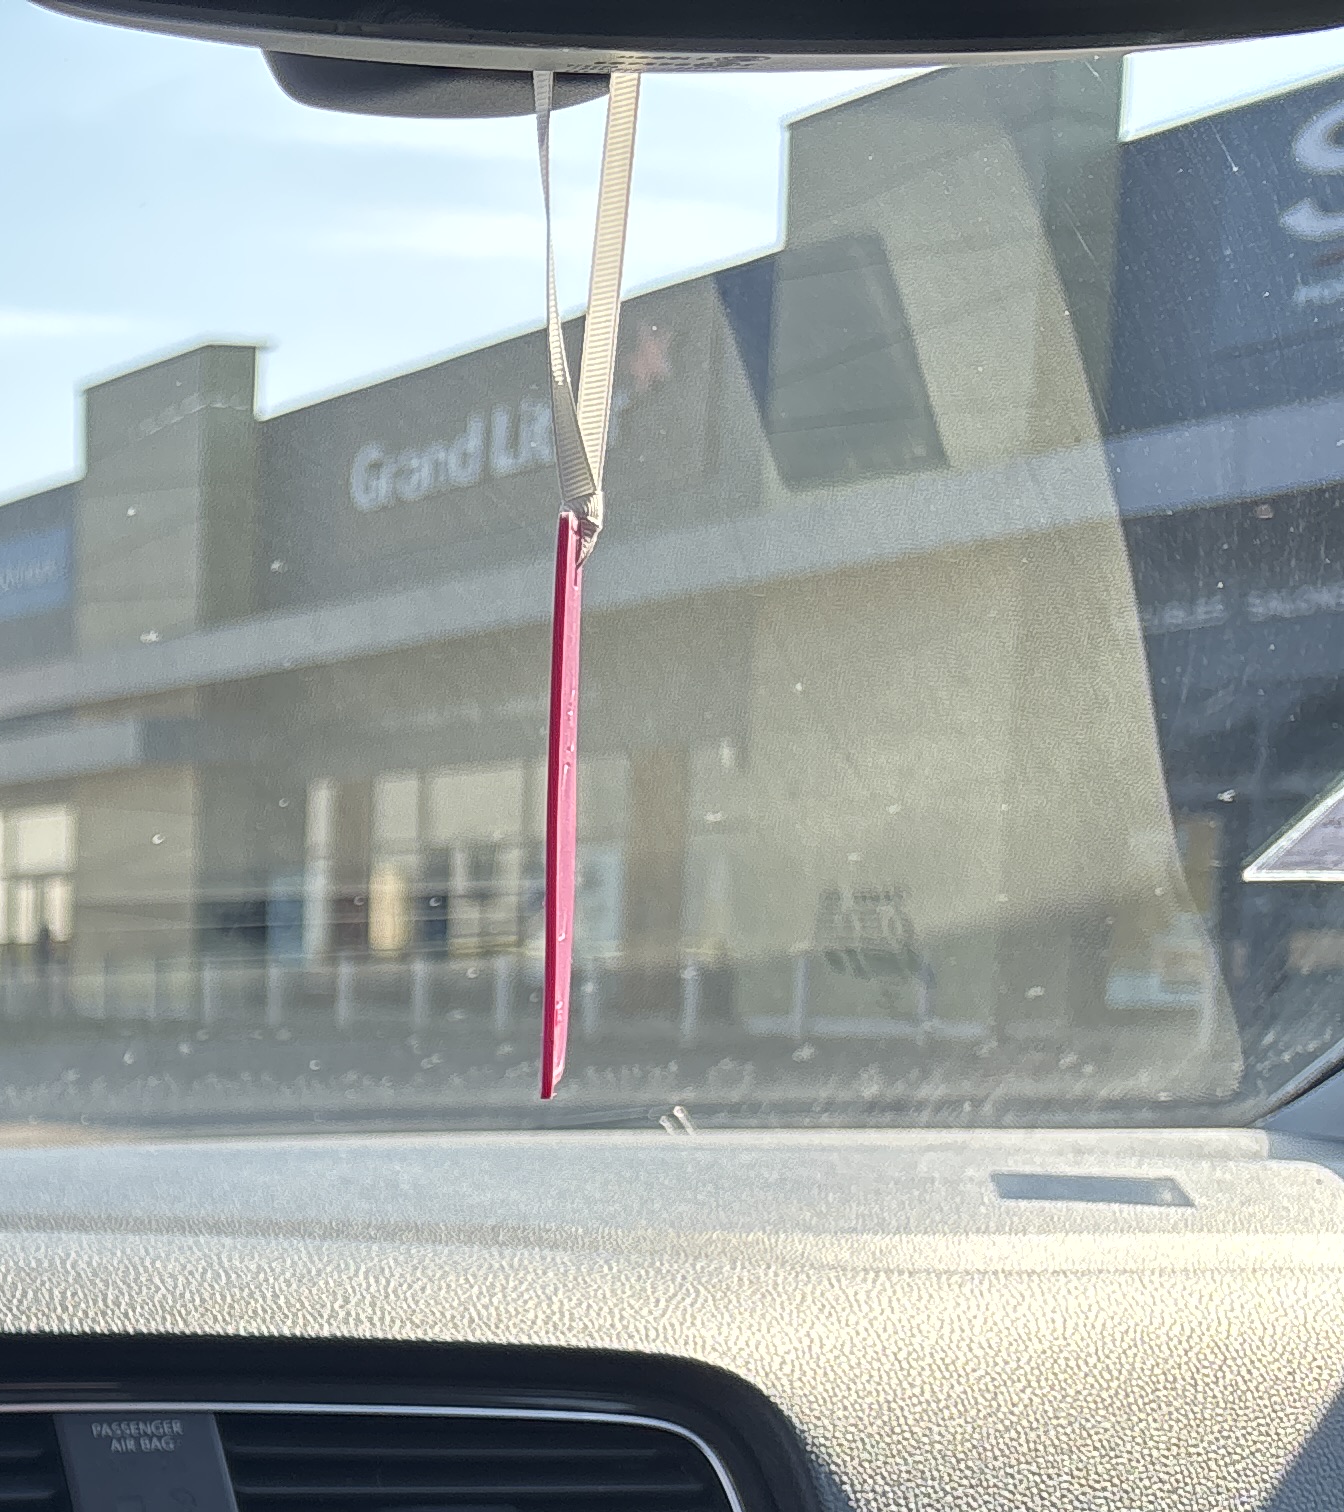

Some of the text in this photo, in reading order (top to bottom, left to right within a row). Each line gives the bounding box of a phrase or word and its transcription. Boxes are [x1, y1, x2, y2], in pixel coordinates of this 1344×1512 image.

[350, 410, 485, 512] Grand
[91, 1419, 184, 1438] PASSENGER
[110, 1436, 175, 1453] AIR BAG
